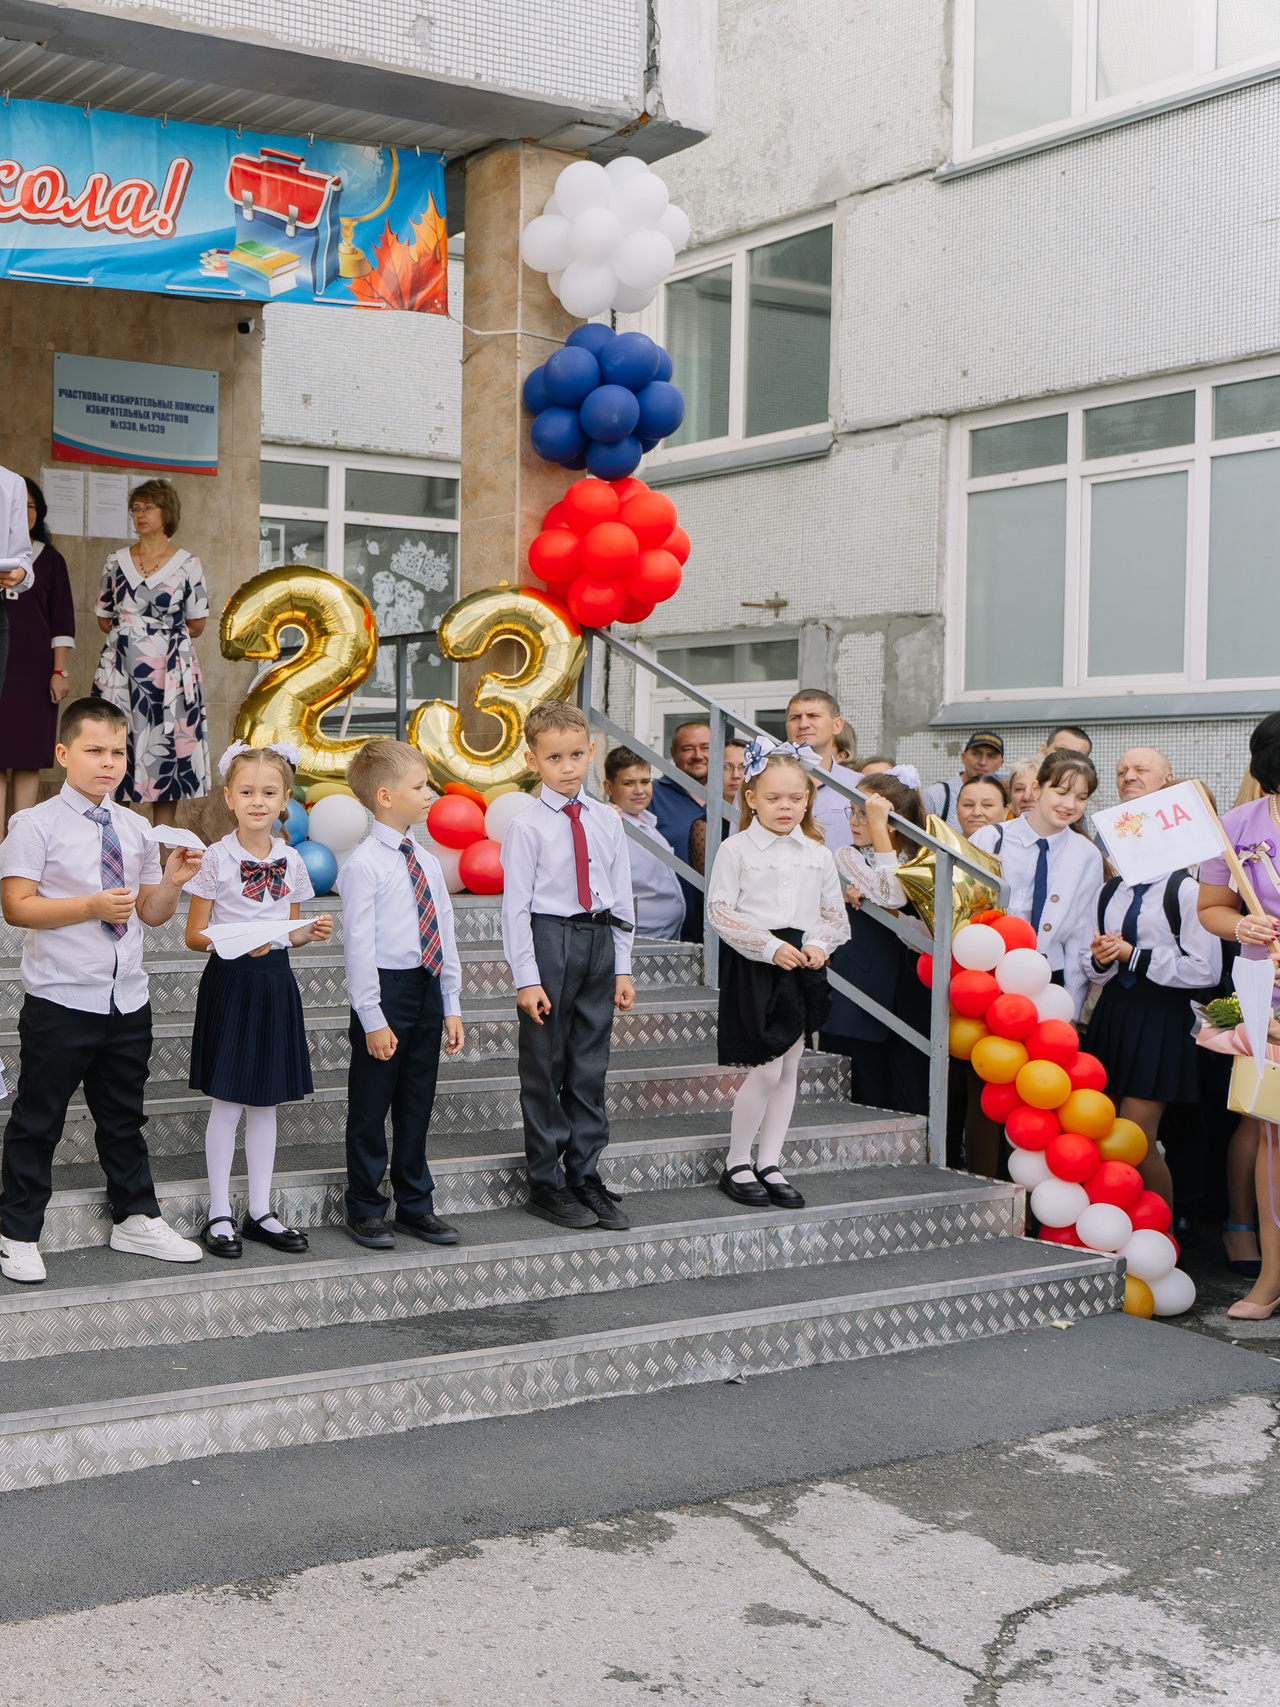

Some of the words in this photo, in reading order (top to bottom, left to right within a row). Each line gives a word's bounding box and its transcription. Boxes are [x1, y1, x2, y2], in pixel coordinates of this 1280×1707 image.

[58, 388, 109, 403] УЧАСТКОВЫЕ
[110, 393, 173, 409] ИЗБИРАТЕЛЬНЫЕ
[175, 401, 215, 414] КОМИССИИ
[85, 404, 150, 419] ИЗБИРАТЕЛЬНЫХ
[151, 411, 189, 424] УЧАСТКОВ
[110, 420, 138, 432] №1338,
[139, 423, 165, 434] №1339
